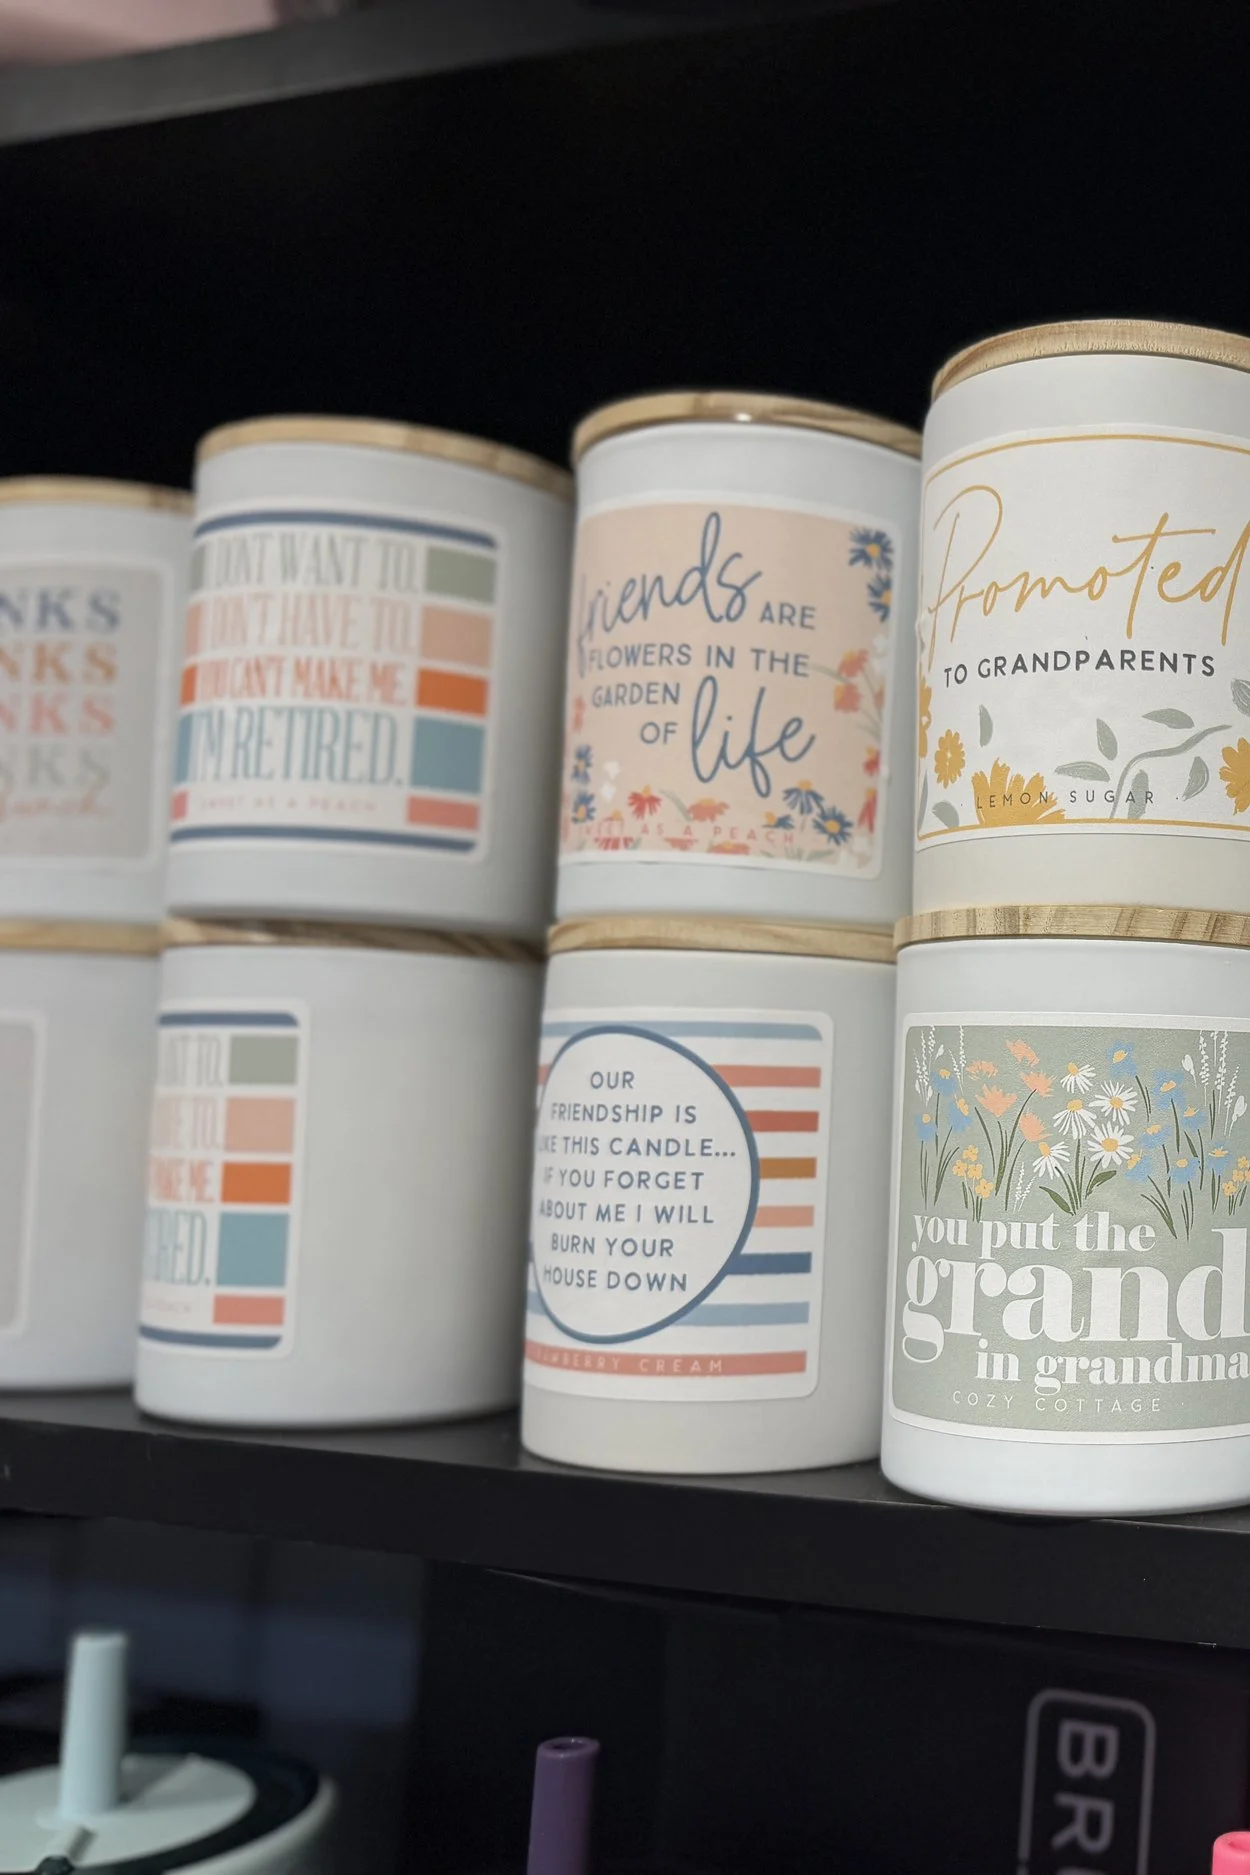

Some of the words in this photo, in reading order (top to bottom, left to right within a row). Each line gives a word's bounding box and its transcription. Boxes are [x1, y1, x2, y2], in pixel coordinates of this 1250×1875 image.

[759, 602, 817, 630] ARE
[588, 642, 692, 671] FLOWERS
[706, 645, 735, 669] IN
[750, 648, 810, 677] THE
[944, 664, 968, 688] TO
[977, 649, 1216, 677] GRANDPARENTS
[293, 654, 364, 702] MAKE
[592, 682, 681, 707] GARDEN
[230, 704, 405, 788] RETIRED.
[640, 721, 678, 745] OF
[691, 675, 816, 799] life
[977, 790, 1048, 809] LEMON
[1069, 790, 1154, 804] SUGAR
[641, 823, 664, 836] AS
[683, 825, 693, 836] A
[714, 826, 794, 844] PEACH
[590, 1070, 635, 1090] OUR
[551, 1102, 663, 1124] FRIENDSHIP
[675, 1104, 697, 1124] IS
[563, 1135, 600, 1156] THIS
[610, 1137, 736, 1158] CANDLE...
[560, 1169, 595, 1189] YOU
[604, 1170, 704, 1191] FORGET
[539, 1200, 587, 1222] ABOUT
[595, 1203, 626, 1222] ME
[654, 1205, 714, 1224] WILL
[551, 1232, 595, 1255] BURN
[605, 1237, 674, 1257] YOUR
[911, 1214, 969, 1252] you
[978, 1213, 1060, 1259] put
[1073, 1211, 1156, 1251] the
[543, 1265, 597, 1289] HOUSE
[607, 1271, 688, 1292] DOWN
[639, 1358, 723, 1373] CREAM
[975, 1337, 1021, 1382] in
[953, 1390, 1013, 1409] COZY
[1035, 1398, 1161, 1413] COTTAGE
[1052, 1718, 1120, 1875] BR
